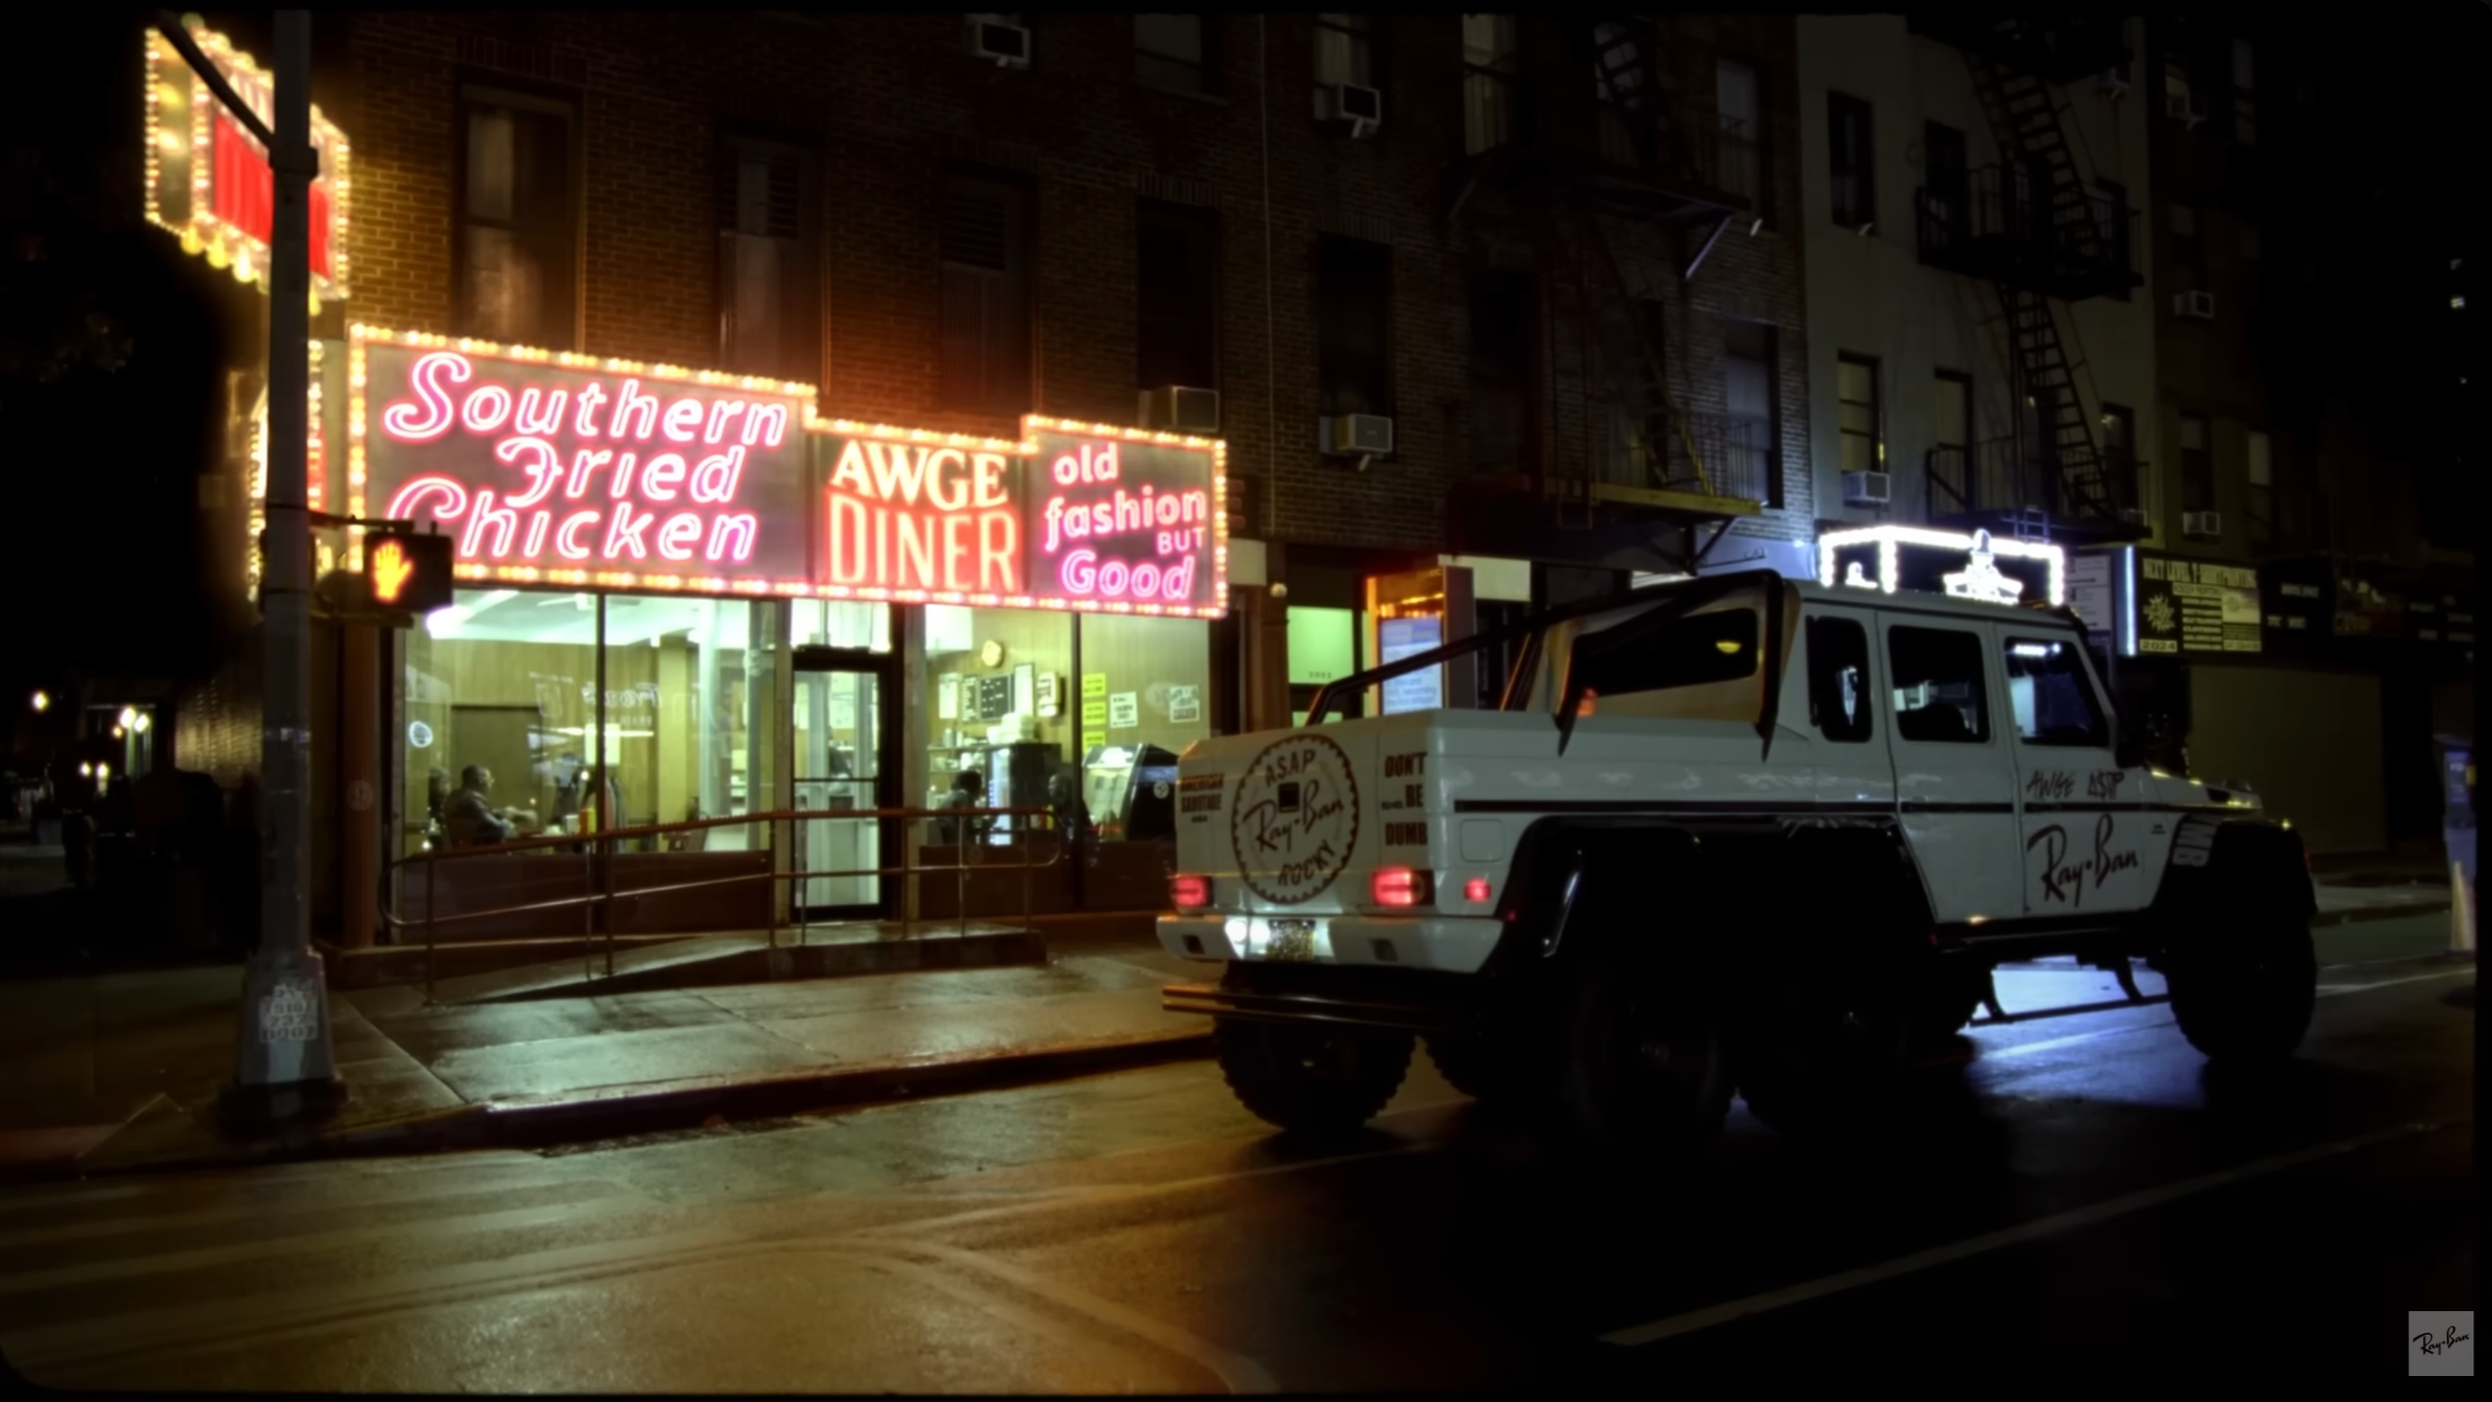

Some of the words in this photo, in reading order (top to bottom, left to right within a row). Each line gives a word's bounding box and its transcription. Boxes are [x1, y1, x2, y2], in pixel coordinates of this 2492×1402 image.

[385, 352, 787, 445] Southern
[497, 435, 746, 507] Fried
[831, 440, 1009, 511] AWGE
[1053, 442, 1118, 485] old
[829, 493, 1019, 593] DINER
[1045, 485, 1207, 553] fashion
[1156, 527, 1207, 555] BUT
[1061, 549, 1195, 600] Good
[2142, 641, 2176, 651] 2024
[1385, 751, 1428, 778] DON'T
[1405, 784, 1423, 808] BE
[1385, 821, 1428, 846] DUMB
[1278, 839, 1335, 887] ROCKY
